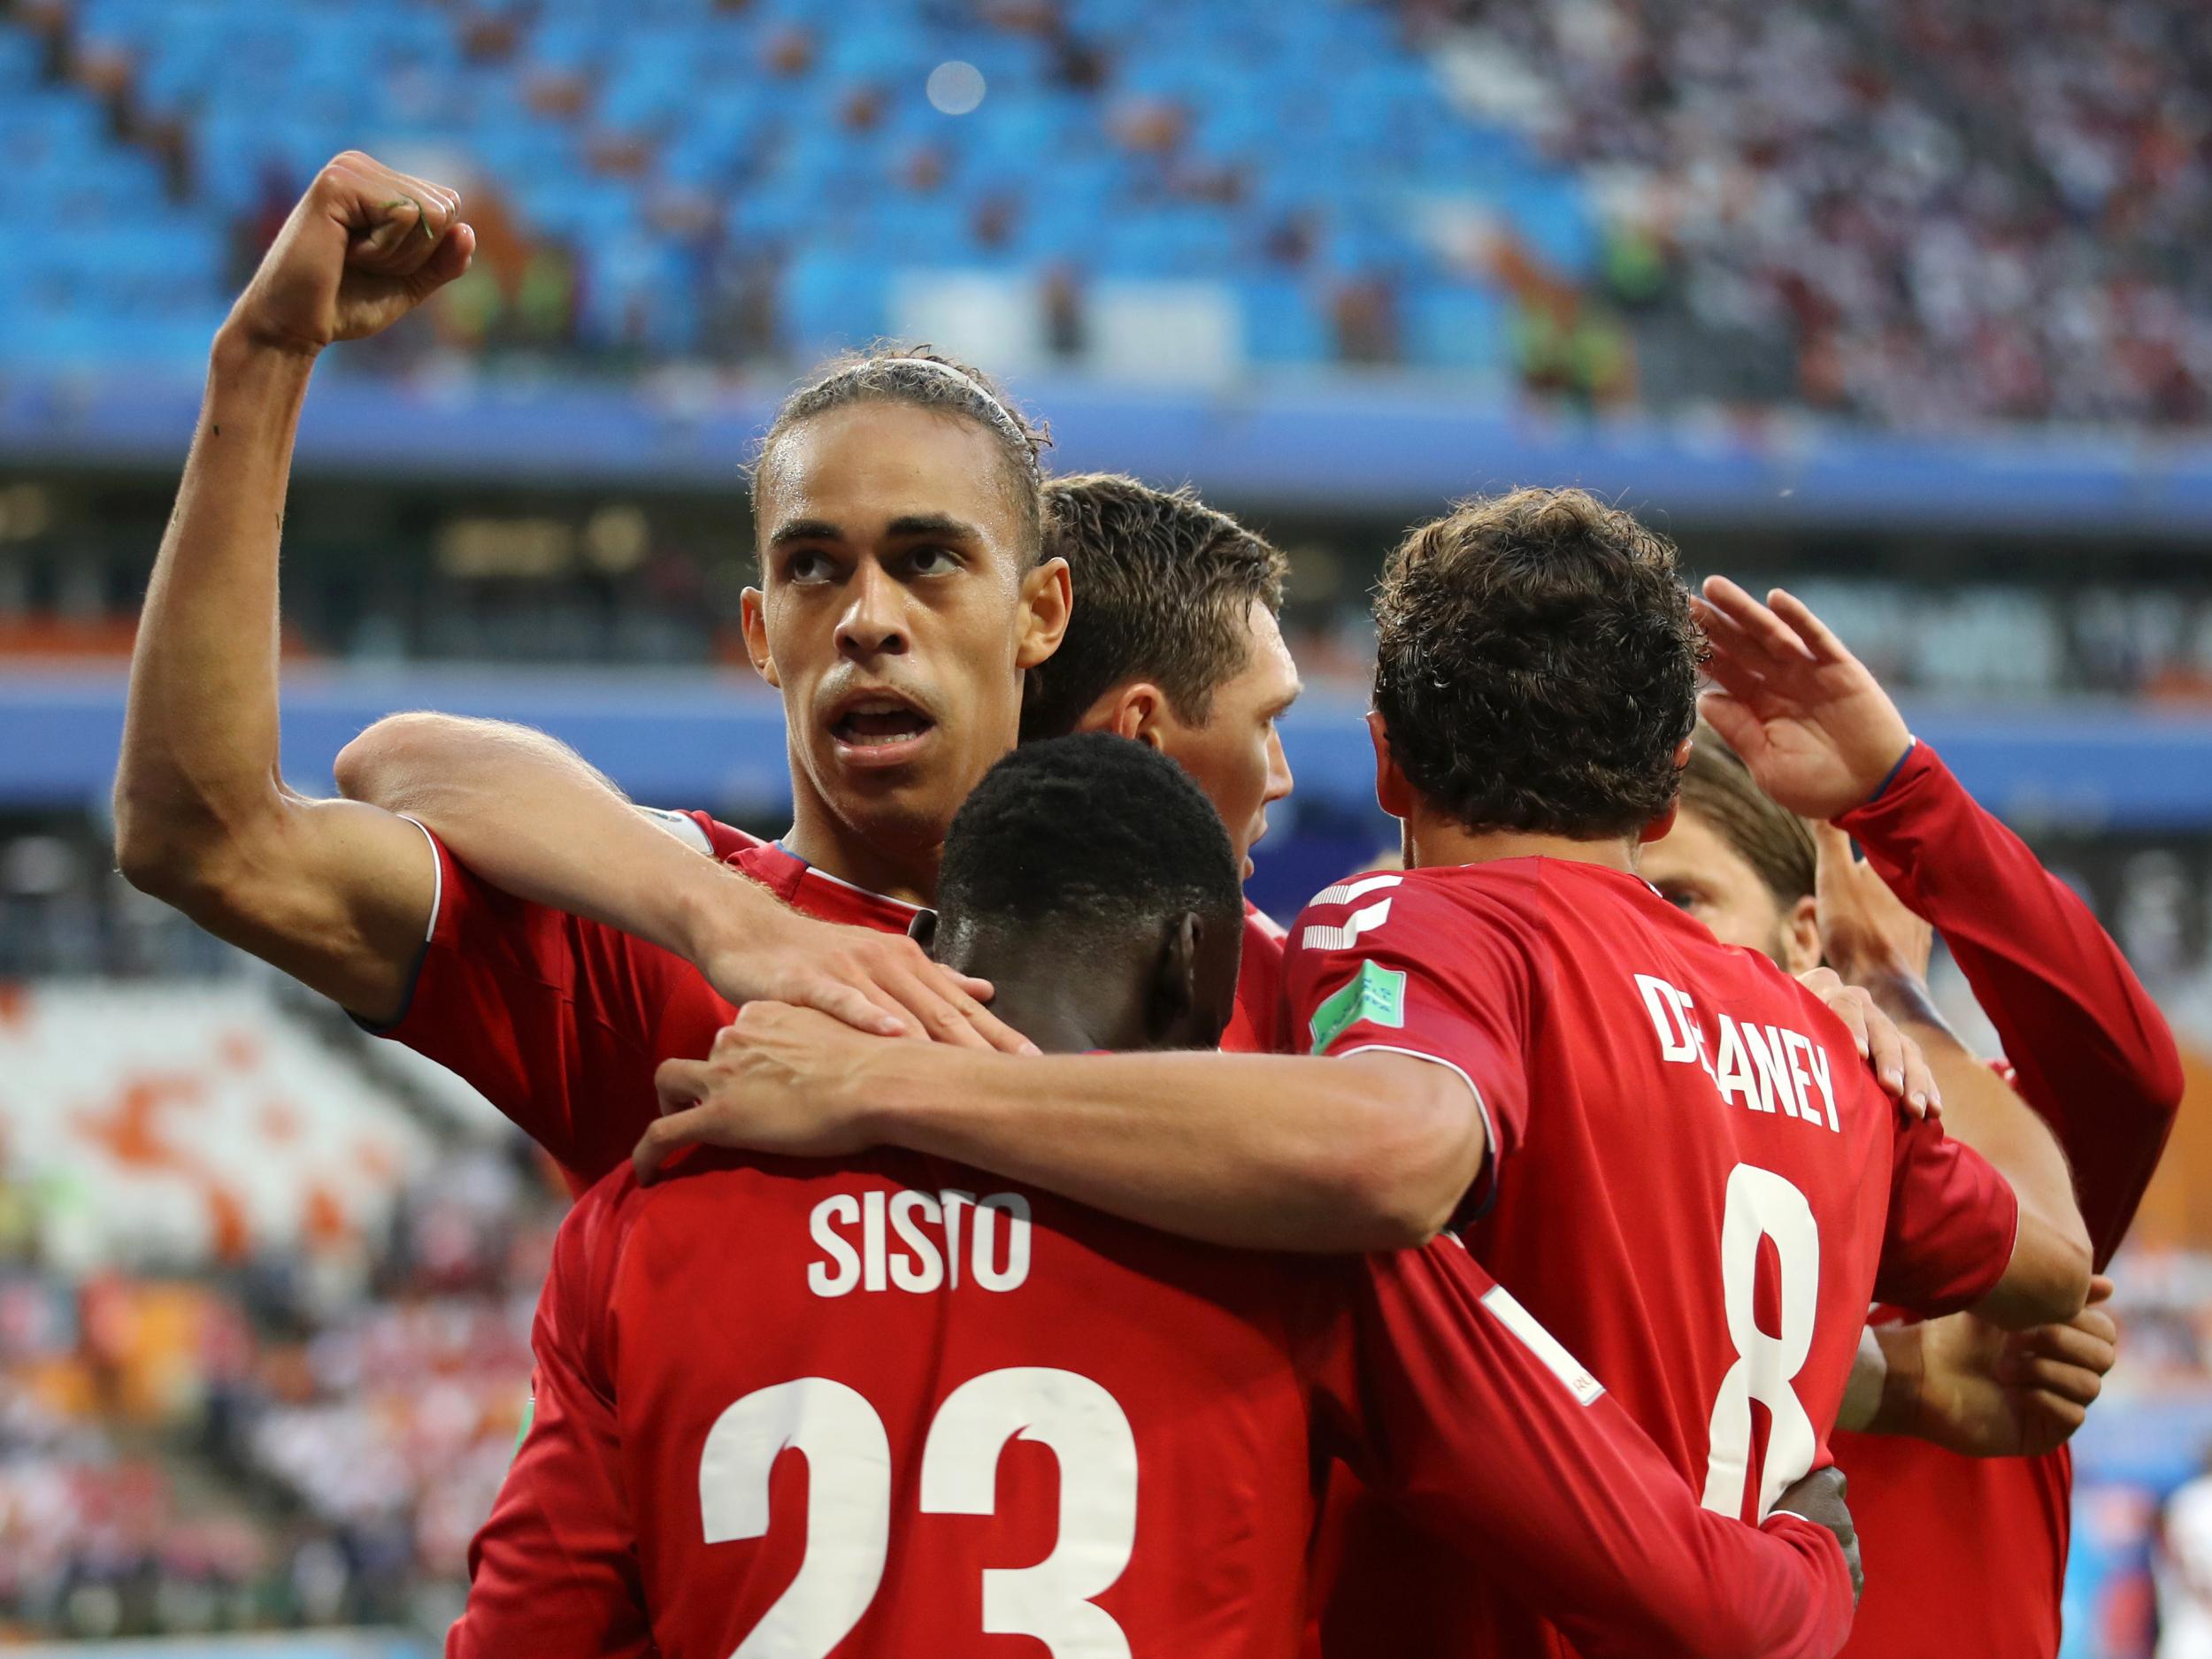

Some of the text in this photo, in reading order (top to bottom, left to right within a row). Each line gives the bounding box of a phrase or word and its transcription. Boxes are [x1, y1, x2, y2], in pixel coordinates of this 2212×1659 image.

[1633, 973, 1840, 1133] DEANEY
[807, 1189, 1032, 1298] SISTO
[1701, 1162, 1820, 1526] 8
[699, 1366, 1139, 1659] 23
